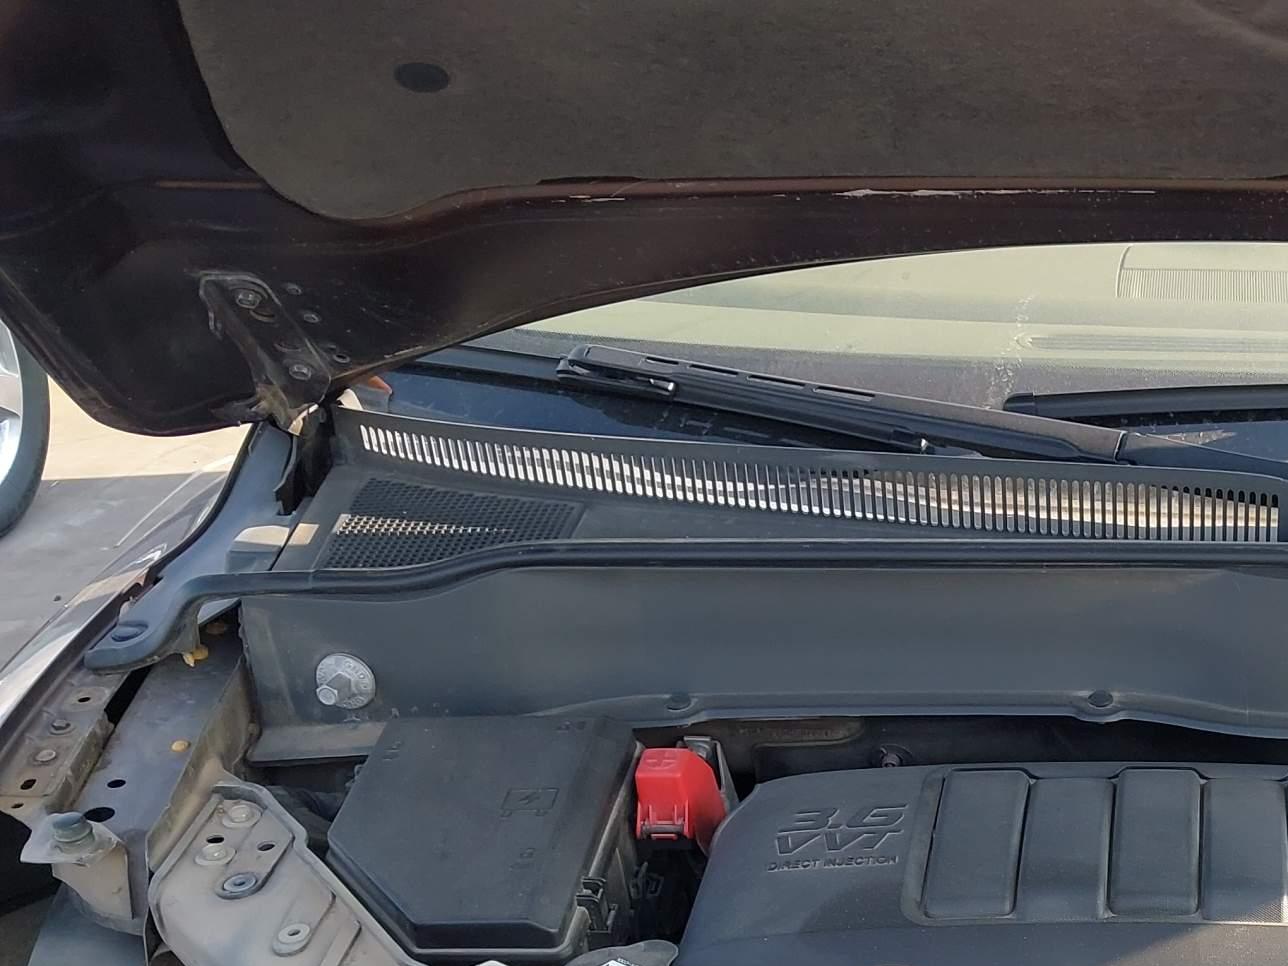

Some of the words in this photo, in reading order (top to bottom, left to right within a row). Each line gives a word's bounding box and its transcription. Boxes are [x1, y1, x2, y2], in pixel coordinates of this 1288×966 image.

[776, 804, 910, 835] 3.6
[767, 858, 820, 872] DIRECT
[824, 855, 899, 869] INJECTION
